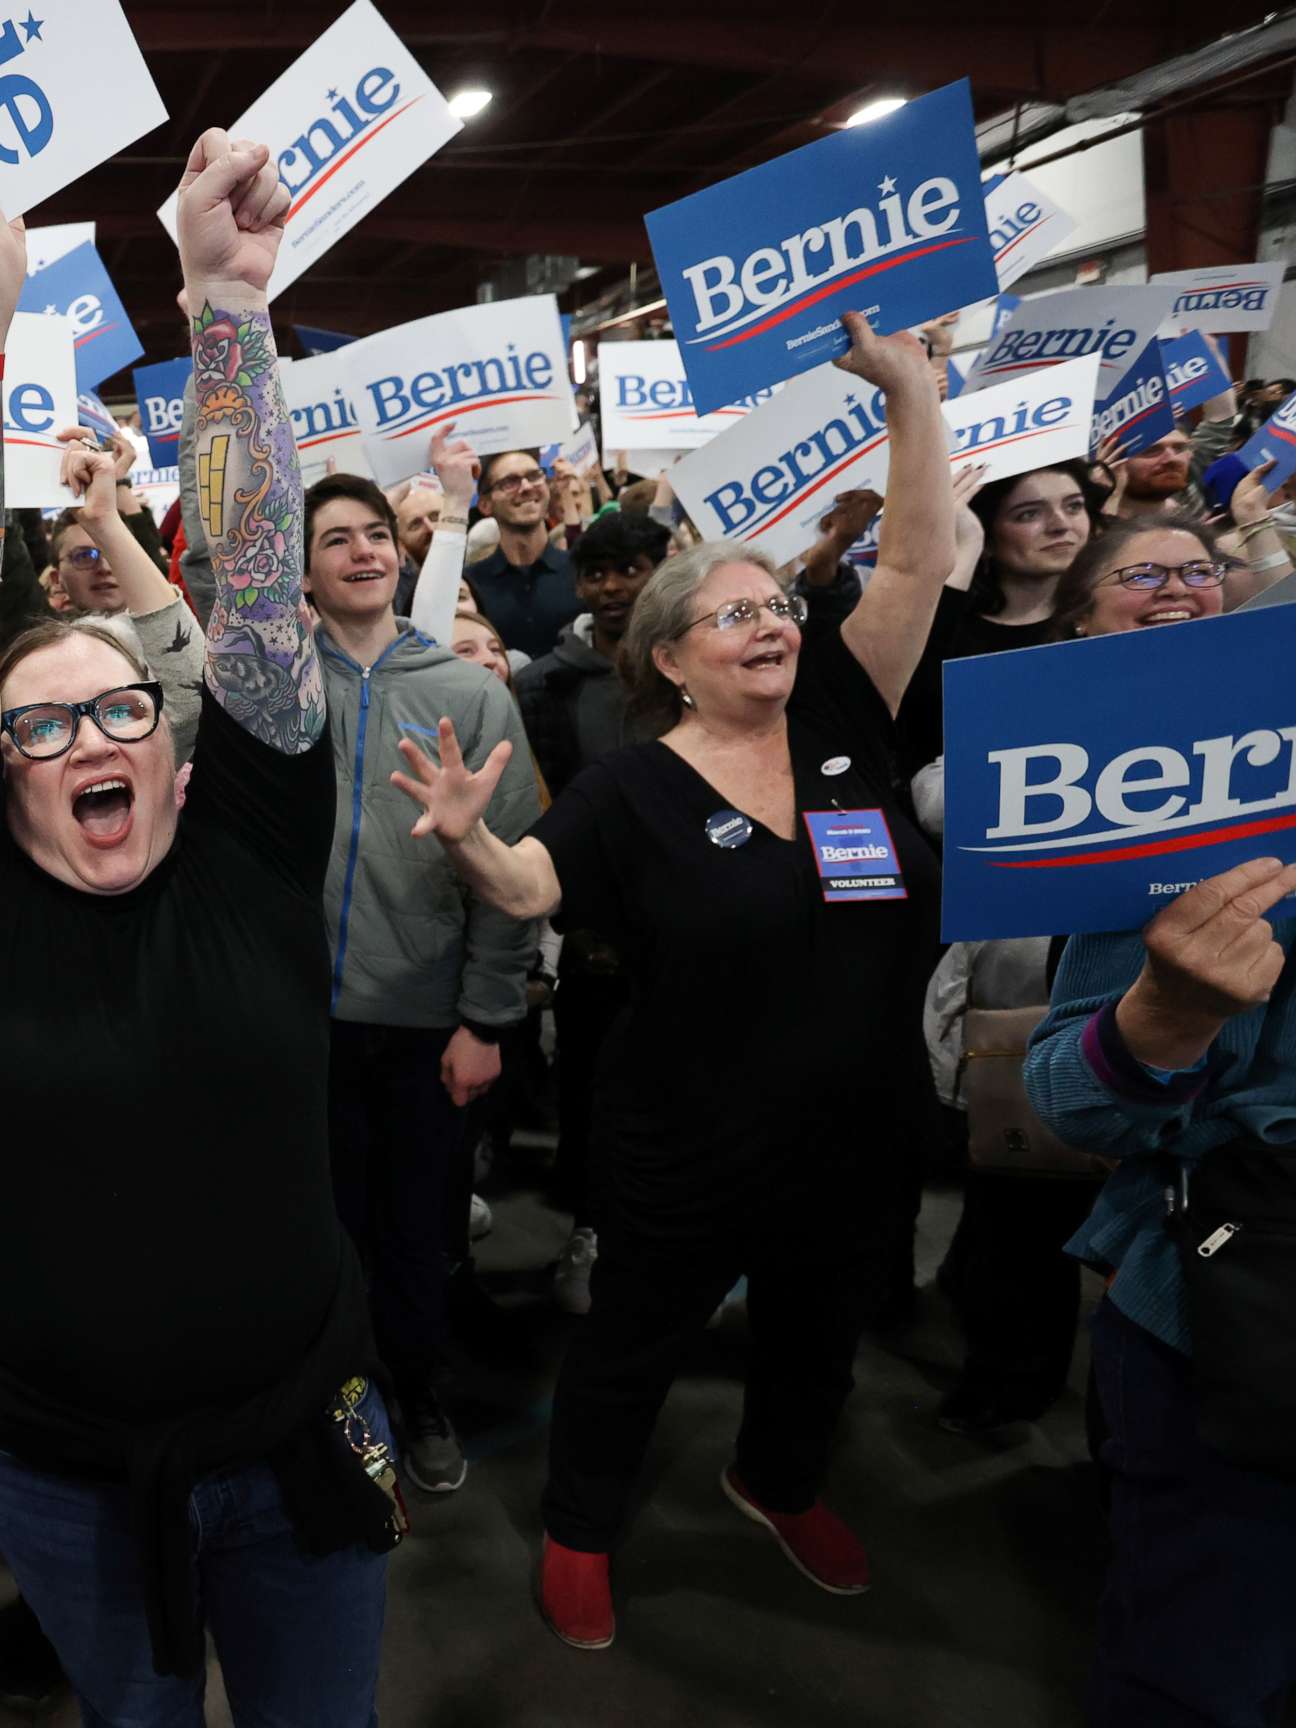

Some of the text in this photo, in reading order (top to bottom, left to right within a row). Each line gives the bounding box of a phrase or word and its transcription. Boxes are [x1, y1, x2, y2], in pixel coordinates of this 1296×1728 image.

[277, 67, 401, 199] rnie
[989, 200, 1042, 251] nie
[681, 174, 961, 332] Bernie
[1170, 289, 1271, 320] Berni
[985, 319, 1137, 361] Bernie
[366, 344, 554, 427] Bernie
[986, 726, 1296, 840] Ber
[820, 844, 889, 862] Bernie
[830, 877, 896, 888] VOLUNTEER
